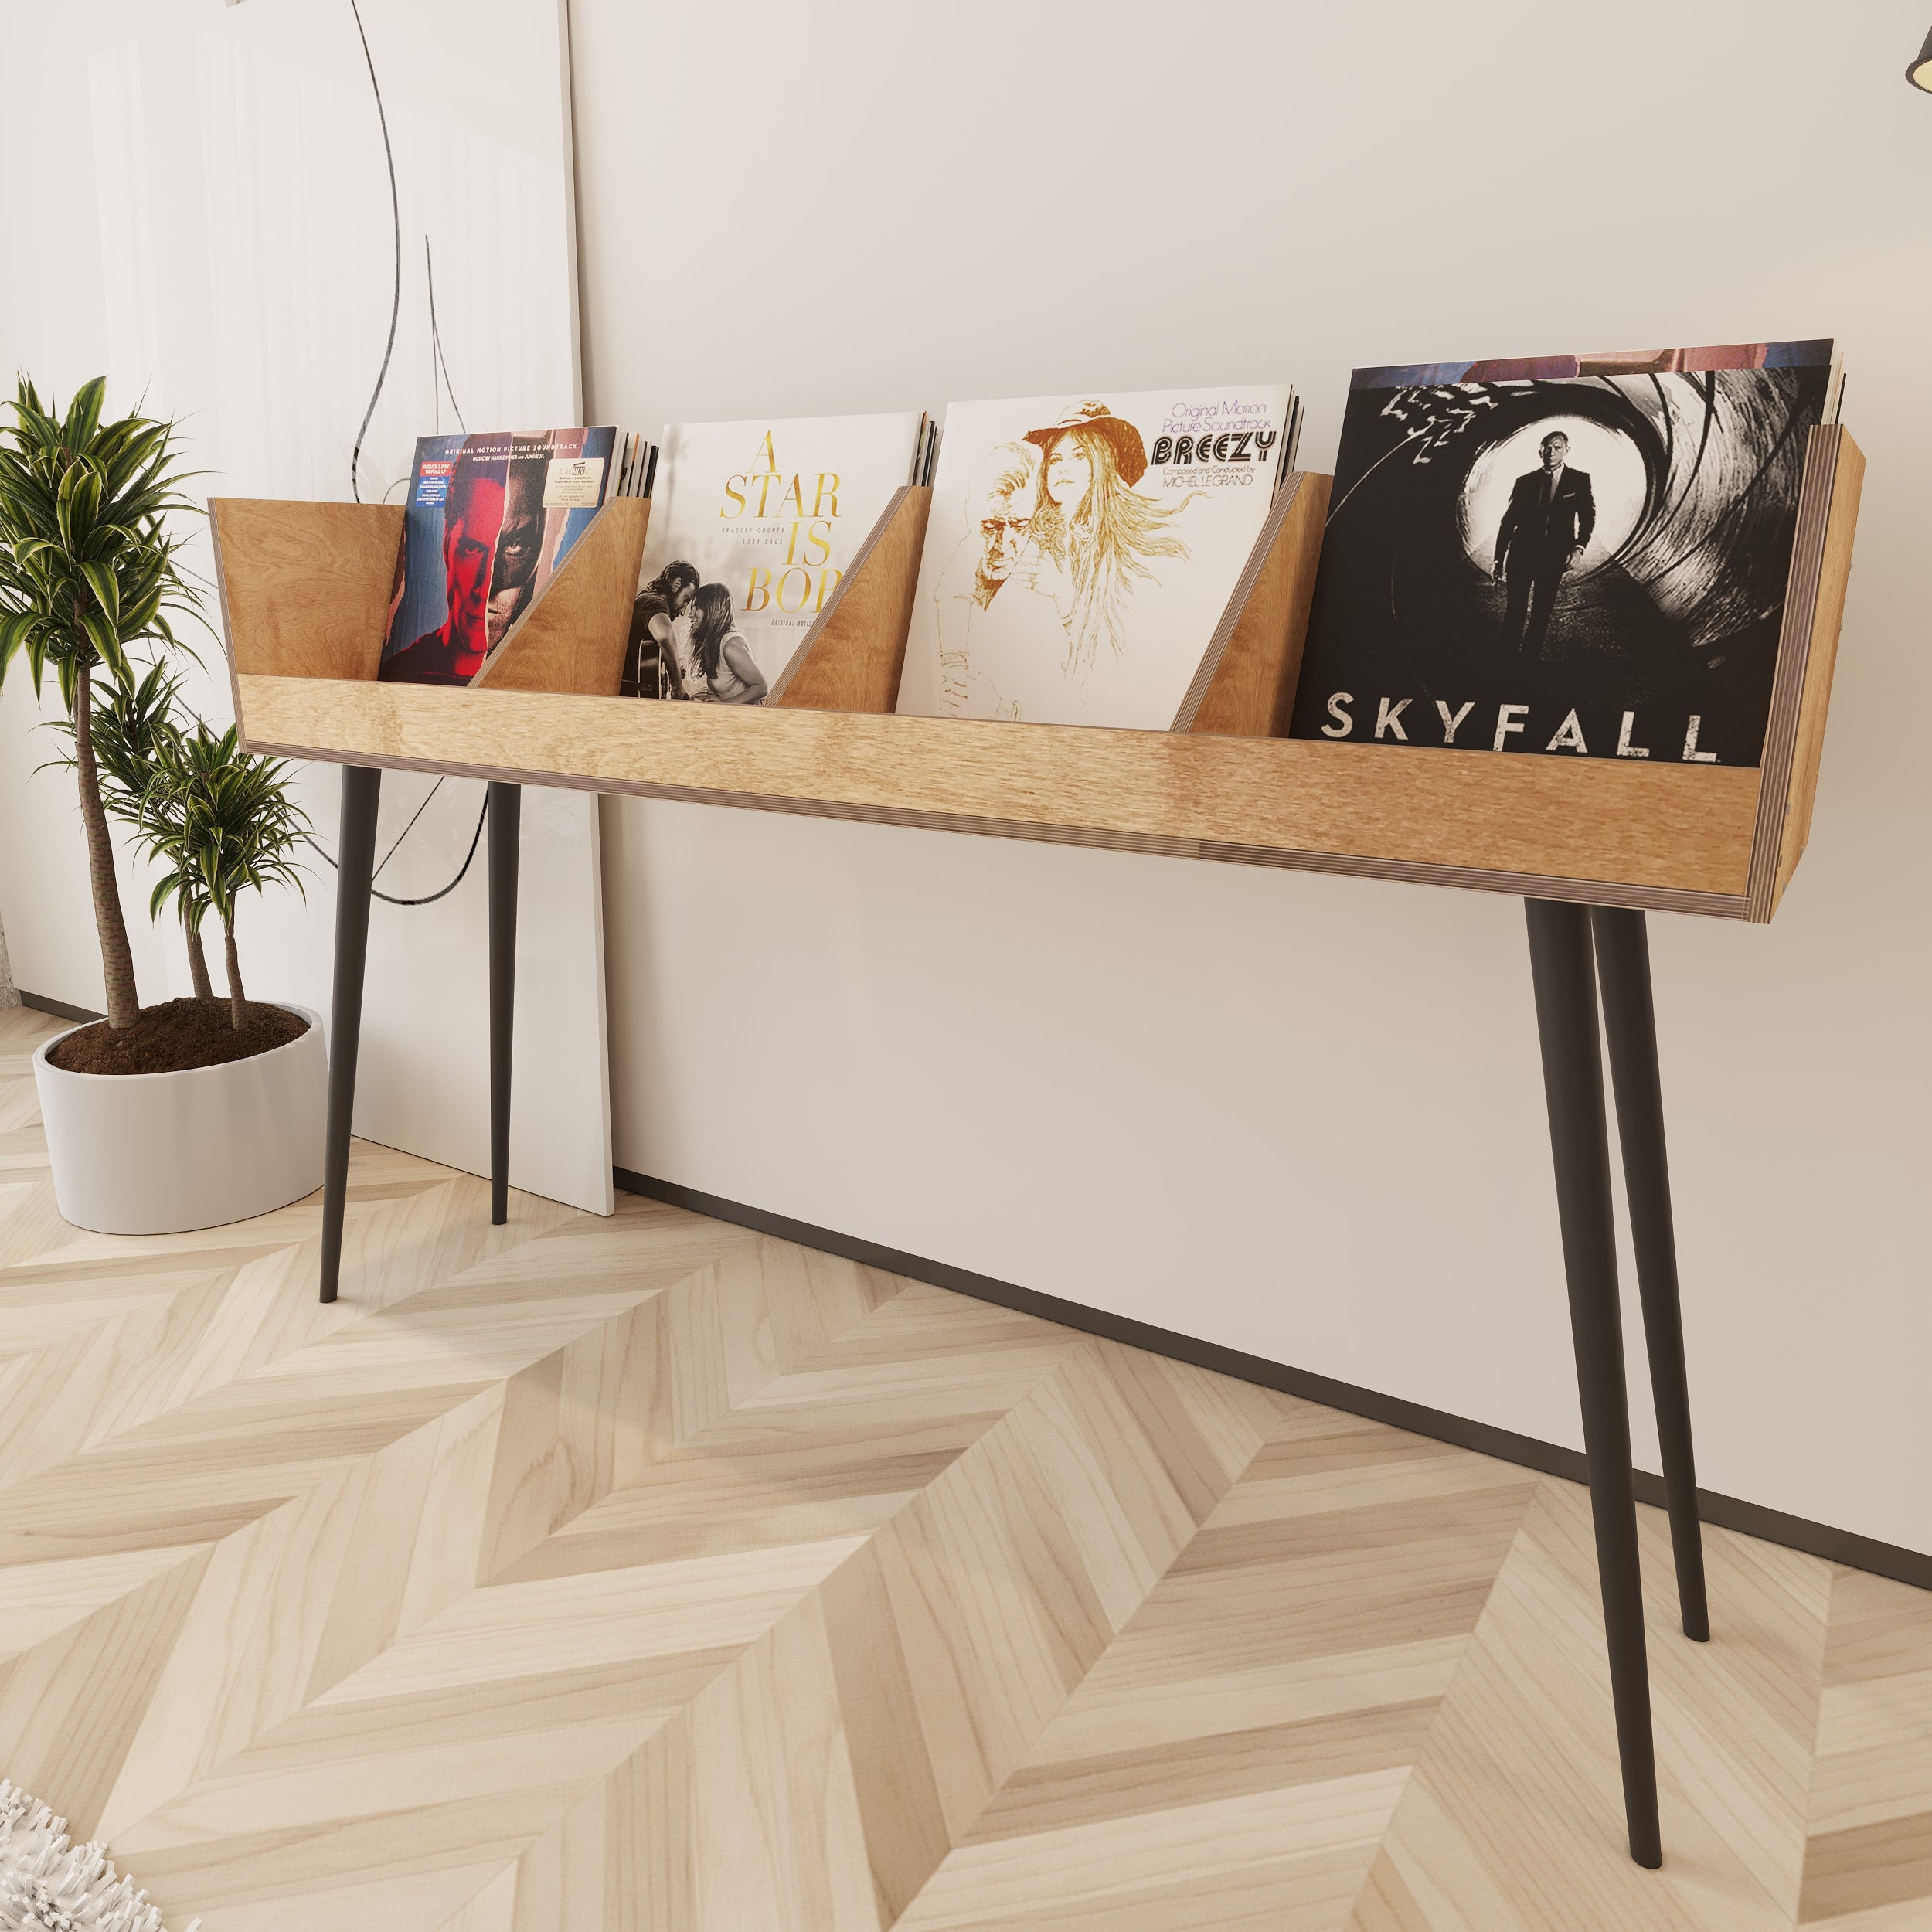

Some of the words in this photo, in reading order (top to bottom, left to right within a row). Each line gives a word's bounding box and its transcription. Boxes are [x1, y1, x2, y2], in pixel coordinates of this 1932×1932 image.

[1162, 418, 1202, 433] Picture
[1202, 417, 1271, 432] Soundtrack
[1172, 401, 1219, 421] Original
[1221, 400, 1267, 415] Motion
[745, 429, 780, 474] A
[1151, 430, 1277, 465] BREEZY
[1162, 466, 1197, 475] Composed
[1211, 465, 1246, 474] Conducted
[1247, 465, 1255, 474] by
[719, 473, 842, 519] STAR
[781, 520, 832, 566] IS
[1321, 692, 1718, 763] SKYFALL
